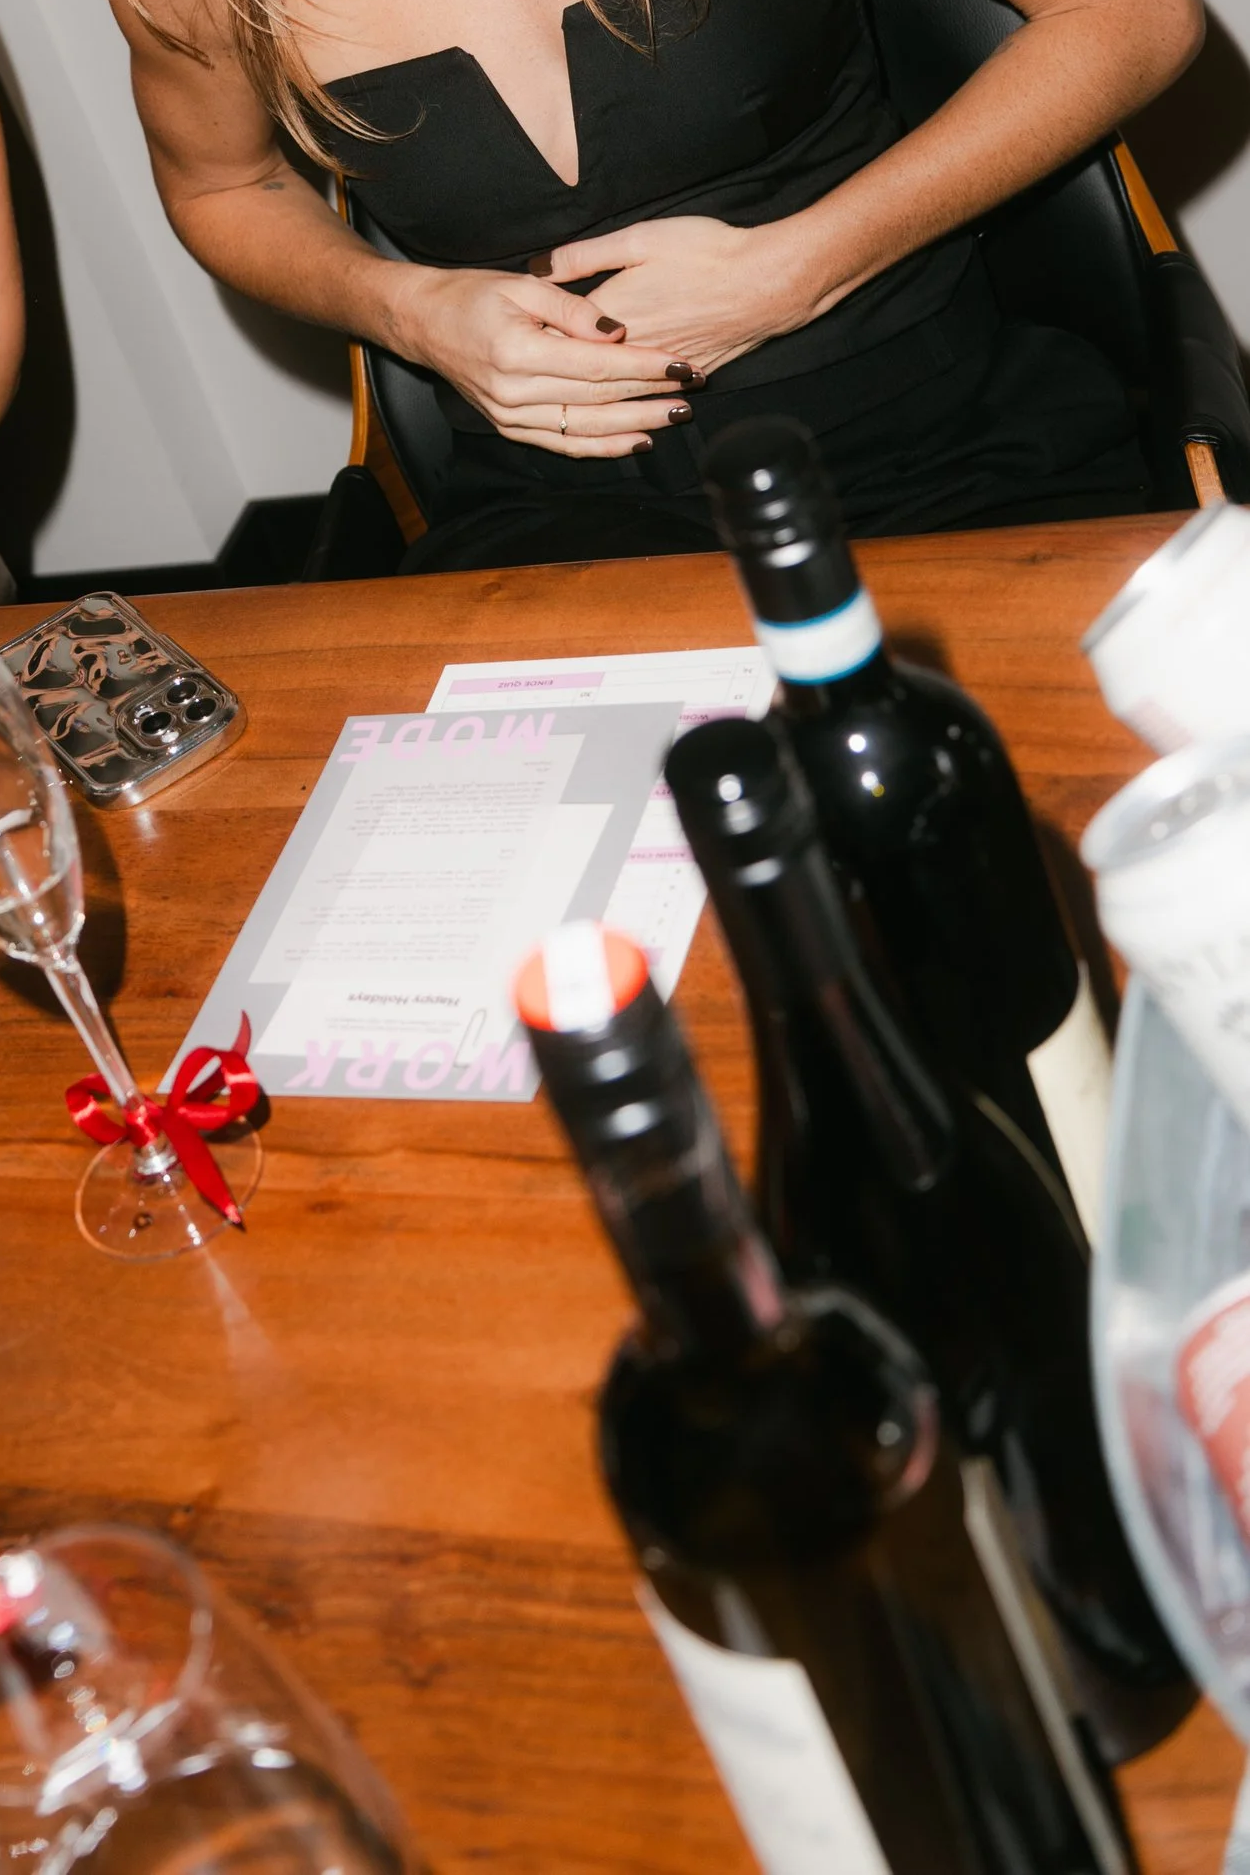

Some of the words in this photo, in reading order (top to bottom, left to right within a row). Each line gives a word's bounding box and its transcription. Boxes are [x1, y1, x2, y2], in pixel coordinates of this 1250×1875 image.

[497, 681, 522, 690] QUIZ
[525, 678, 554, 687] EINDE
[337, 712, 557, 764] MODE
[347, 991, 409, 1005] Holidays
[411, 994, 462, 1007] Happy
[283, 1039, 531, 1092] WORK
